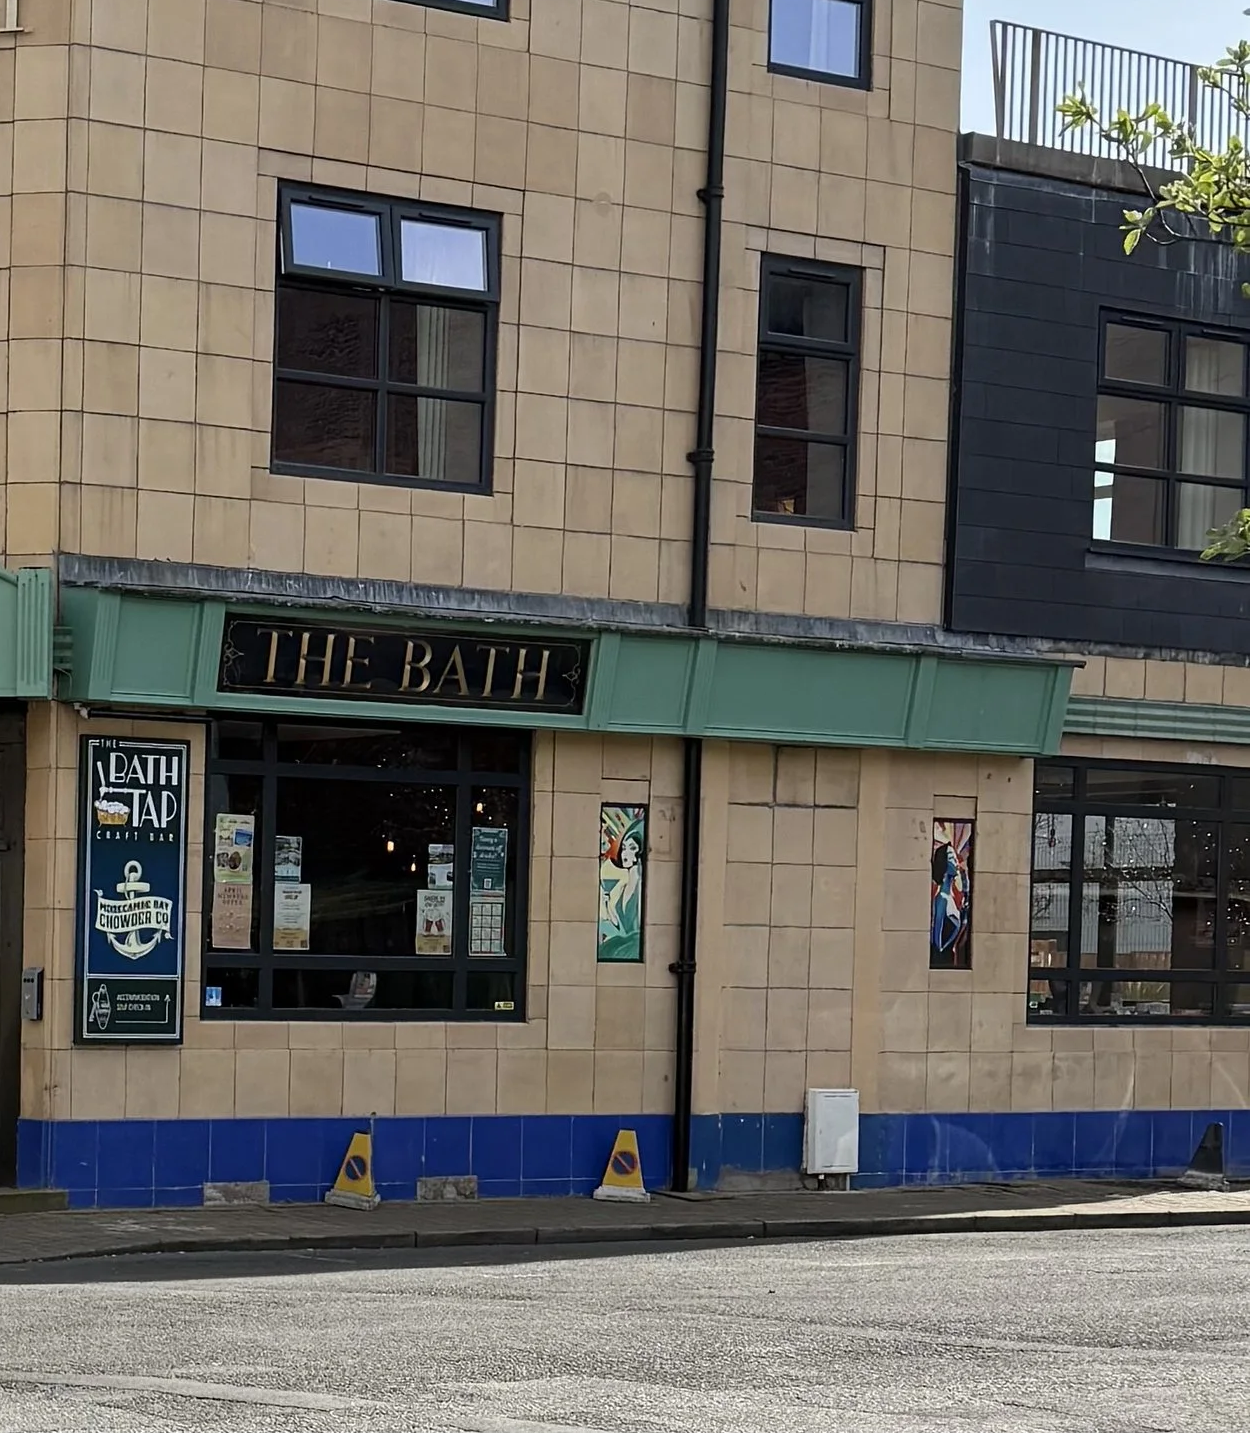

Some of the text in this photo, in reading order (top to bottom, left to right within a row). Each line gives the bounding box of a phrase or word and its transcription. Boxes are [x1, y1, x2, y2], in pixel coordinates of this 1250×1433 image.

[256, 627, 551, 701] THE BATH
[101, 739, 116, 748] THE
[110, 752, 178, 785] BATH
[126, 788, 177, 828] TAP
[96, 830, 174, 842] CRAFT BAR
[153, 899, 169, 910] BAY
[99, 911, 169, 929] CHOWDER CO
